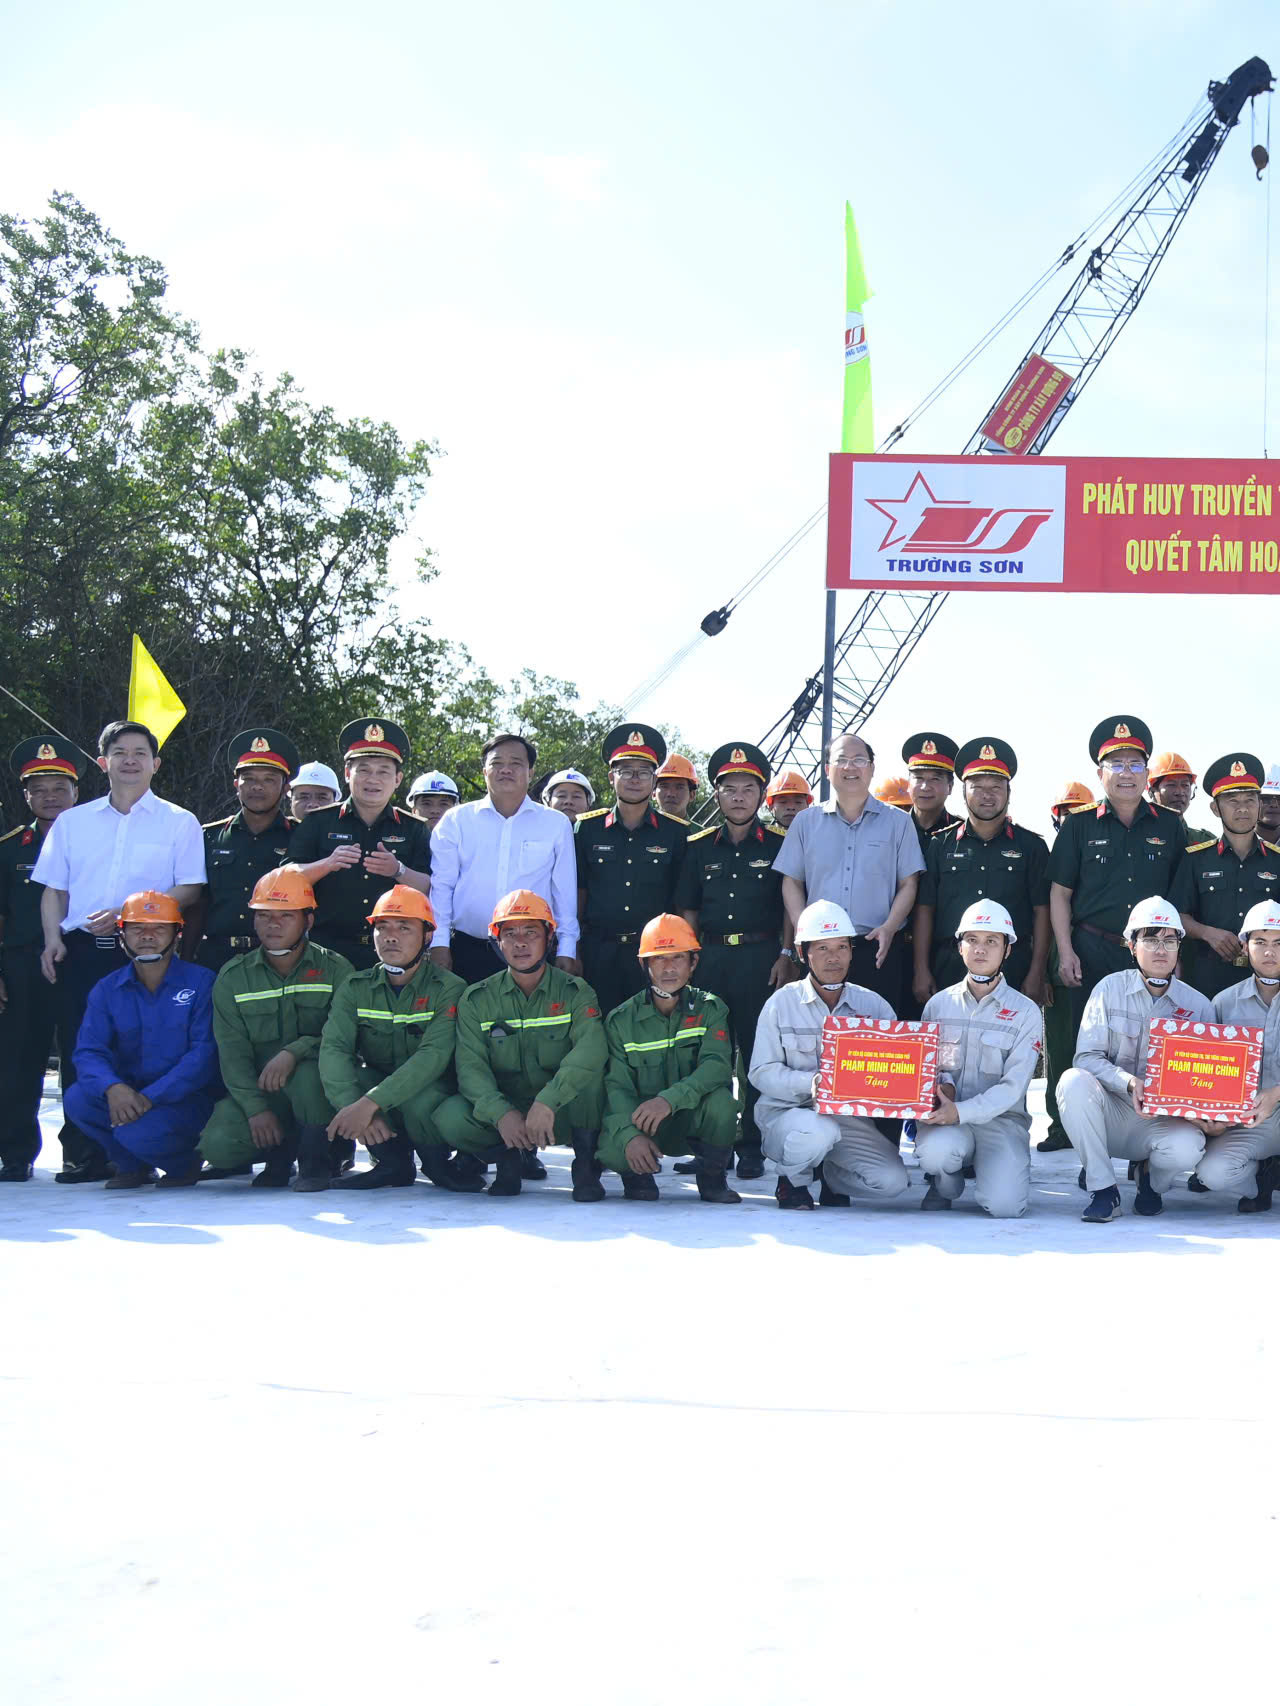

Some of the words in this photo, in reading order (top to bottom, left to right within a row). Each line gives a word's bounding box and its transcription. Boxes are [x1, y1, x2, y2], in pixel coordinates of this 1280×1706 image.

[1084, 477, 1137, 514] PHÁT
[1144, 484, 1184, 515] HUY
[1192, 475, 1272, 516] TRUYỀN
[1127, 530, 1191, 574] QUYẾT
[1198, 534, 1242, 571] TÂM
[886, 557, 972, 574] TRƯỜNG
[979, 559, 1024, 574] SƠN
[841, 1059, 865, 1073] PHẠM
[867, 1062, 889, 1073] MINH
[890, 1061, 915, 1075] CHÍNH
[1168, 1060, 1190, 1074] PHẠM
[1193, 1062, 1214, 1075] MINH
[1216, 1064, 1240, 1078] CHÍNH
[865, 1075, 889, 1088] Tặng
[1191, 1076, 1214, 1089] Tặng
